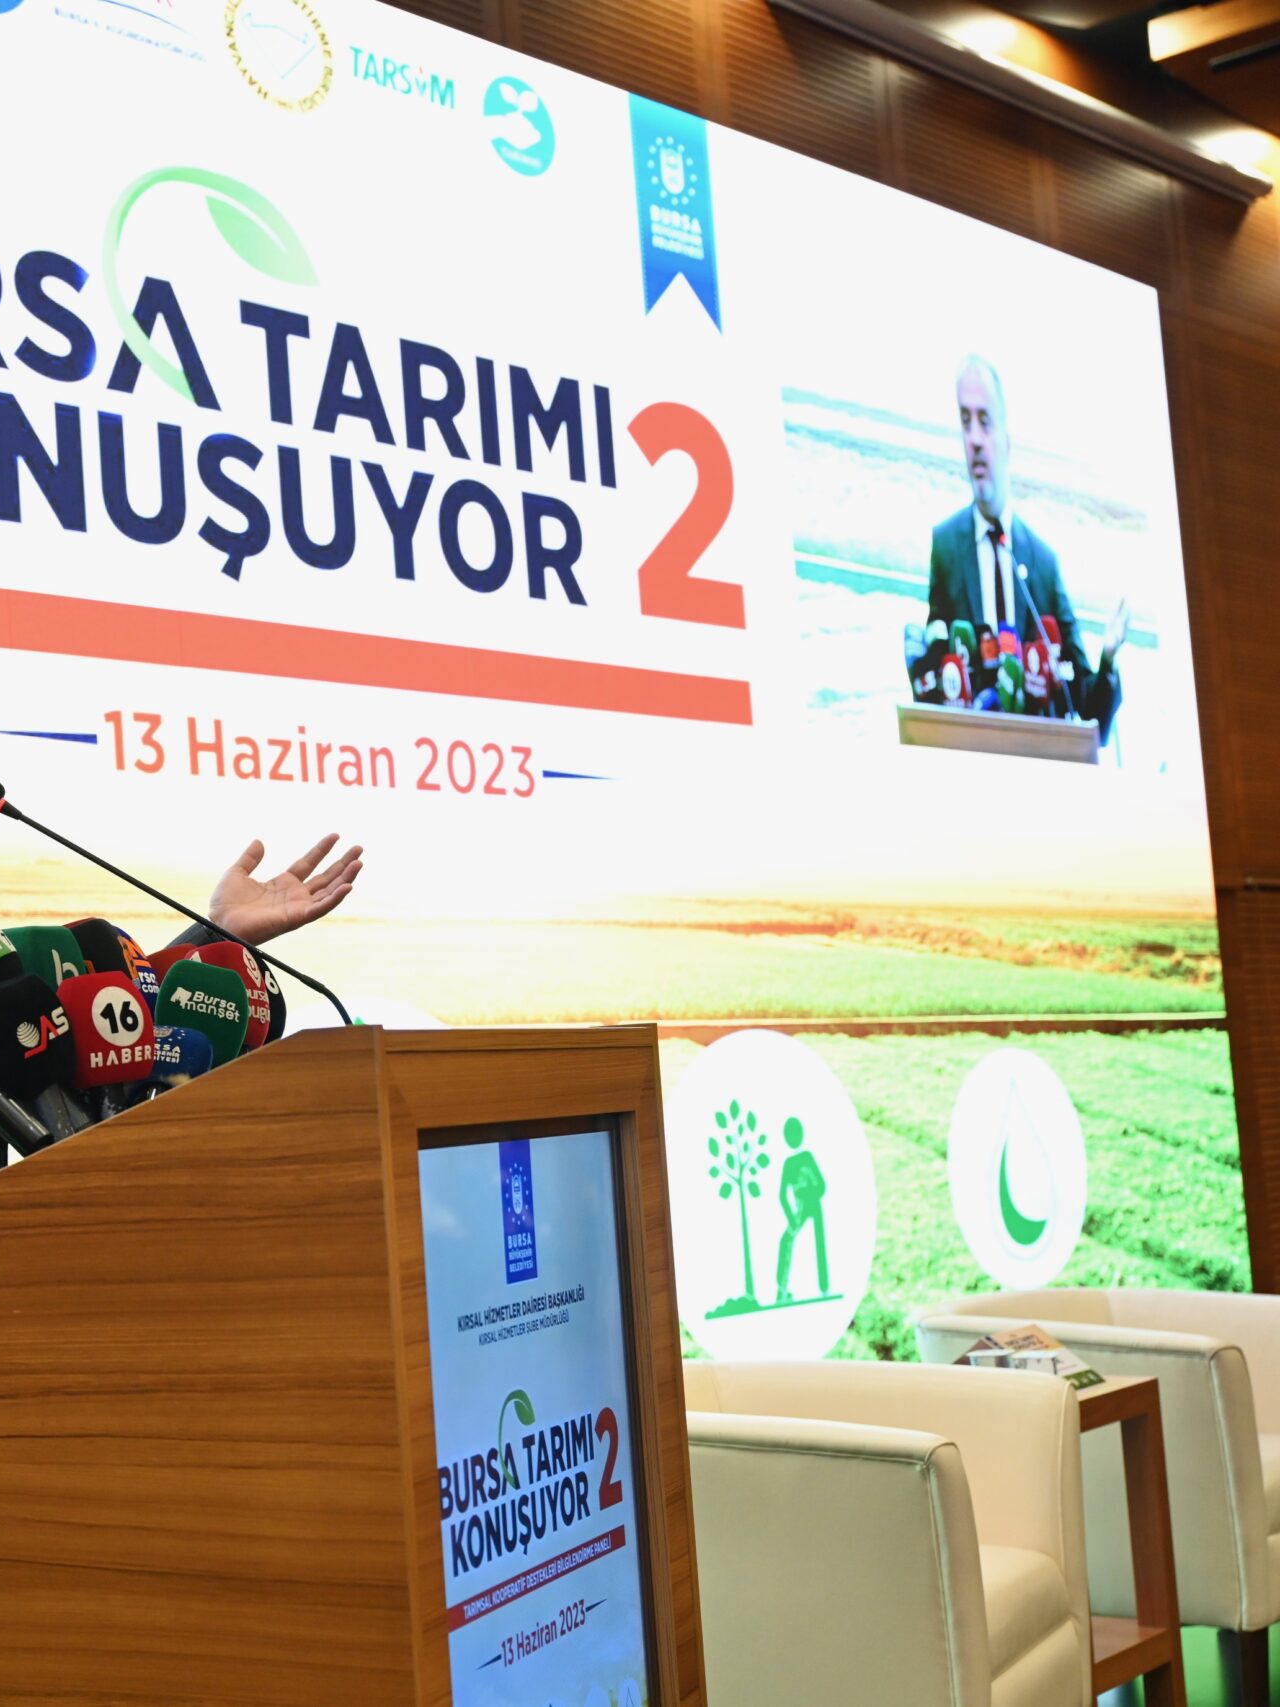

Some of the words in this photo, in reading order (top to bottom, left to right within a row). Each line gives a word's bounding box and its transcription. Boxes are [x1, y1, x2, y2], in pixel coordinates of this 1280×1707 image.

[239, 298, 617, 488] TARIMI
[627, 400, 746, 630] 2
[103, 709, 164, 773] 13
[189, 716, 397, 788] Haziran
[414, 736, 537, 798] 2023
[100, 1001, 139, 1034] 16
[192, 991, 236, 1011] Bursa
[90, 1045, 152, 1068] HABER
[508, 1232, 532, 1249] BURSA
[457, 1311, 483, 1332] KIRSAL
[484, 1302, 521, 1325] HİZMETLER
[522, 1292, 548, 1316] DAİRESİ
[548, 1284, 585, 1309] BAŞKANLIĞI
[437, 1442, 521, 1520] BURSA
[522, 1413, 595, 1485] TARIMI
[450, 1471, 591, 1577] KONUŞUYOR
[594, 1407, 623, 1511] 2
[463, 1594, 493, 1620] TARIMSAL
[501, 1636, 515, 1667] 13
[516, 1619, 558, 1660] Haziran
[559, 1598, 587, 1637] 2023
